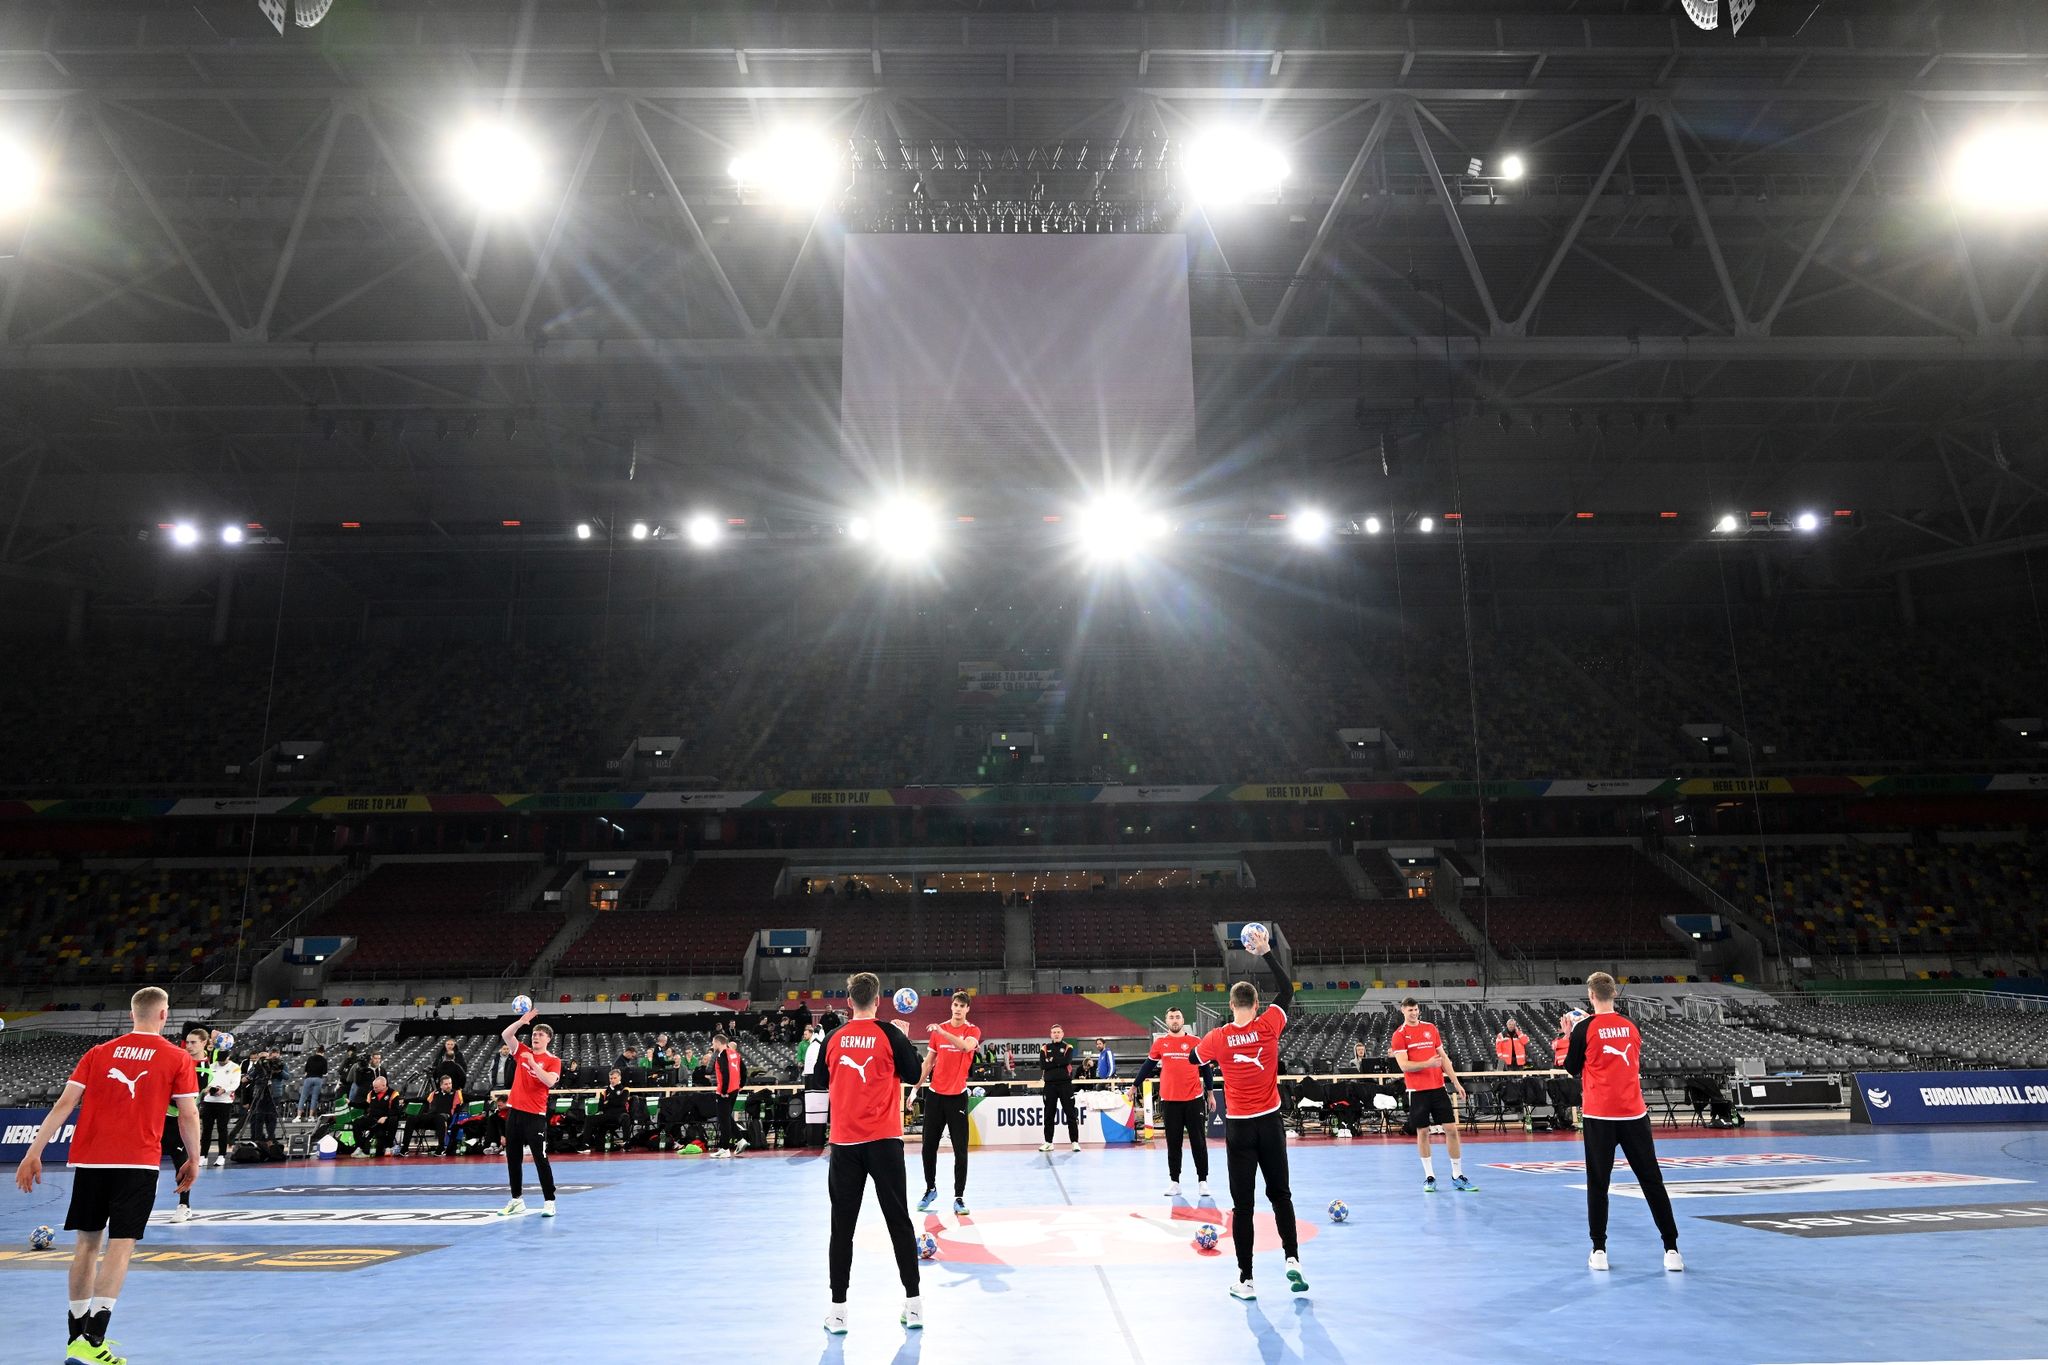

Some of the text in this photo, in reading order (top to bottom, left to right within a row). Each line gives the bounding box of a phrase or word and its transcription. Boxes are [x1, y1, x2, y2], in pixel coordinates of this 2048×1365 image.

[1266, 786, 1324, 798] HERE TO PLAY
[1713, 780, 1769, 792] HERE TO PLAY
[347, 798, 408, 810] HERE TO PLAY
[811, 792, 870, 804] HERE TO PLAY
[1598, 1026, 1631, 1039] GERMANY
[840, 1035, 877, 1049] GERMANY
[1227, 1031, 1259, 1047] GERMANY
[112, 1046, 156, 1061] GERMANY
[1022, 1044, 1041, 1055] EURO
